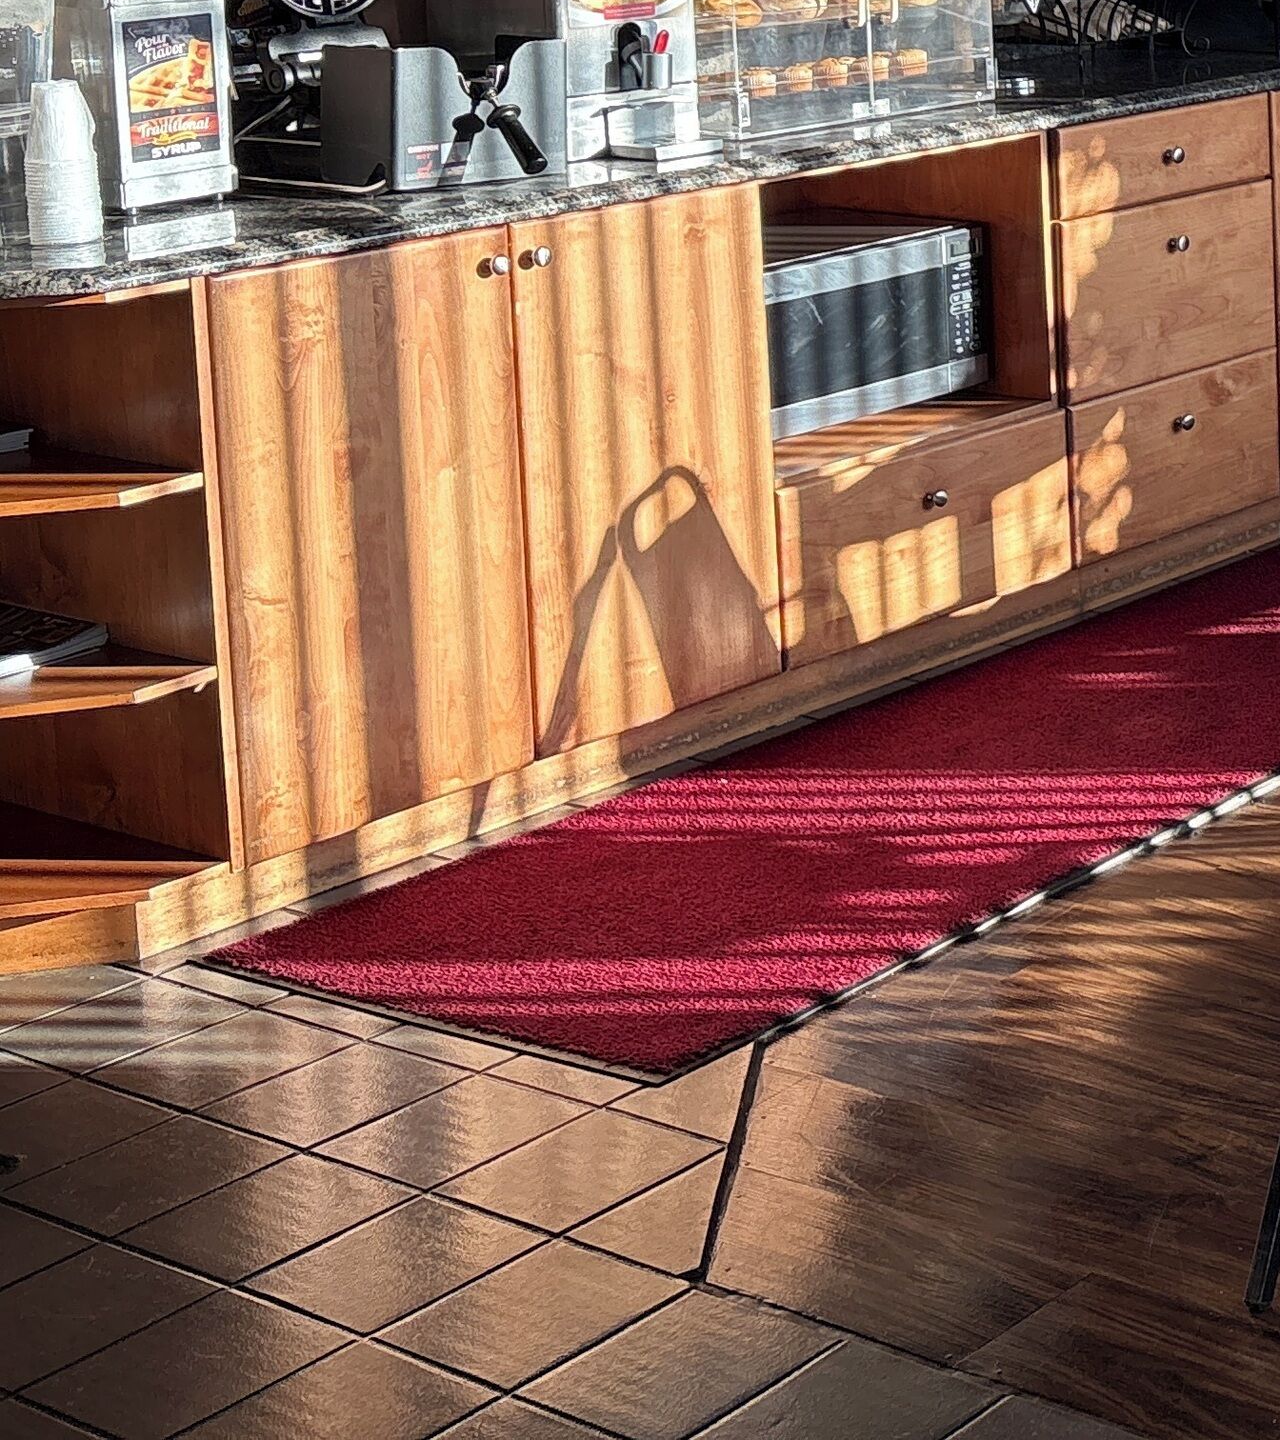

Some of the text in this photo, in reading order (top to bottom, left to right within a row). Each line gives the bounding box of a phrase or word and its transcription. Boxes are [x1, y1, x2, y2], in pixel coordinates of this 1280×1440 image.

[134, 33, 171, 53] Pour
[142, 42, 187, 64] Flavor
[137, 116, 211, 138] Traditional
[151, 141, 202, 159] SYRUP
